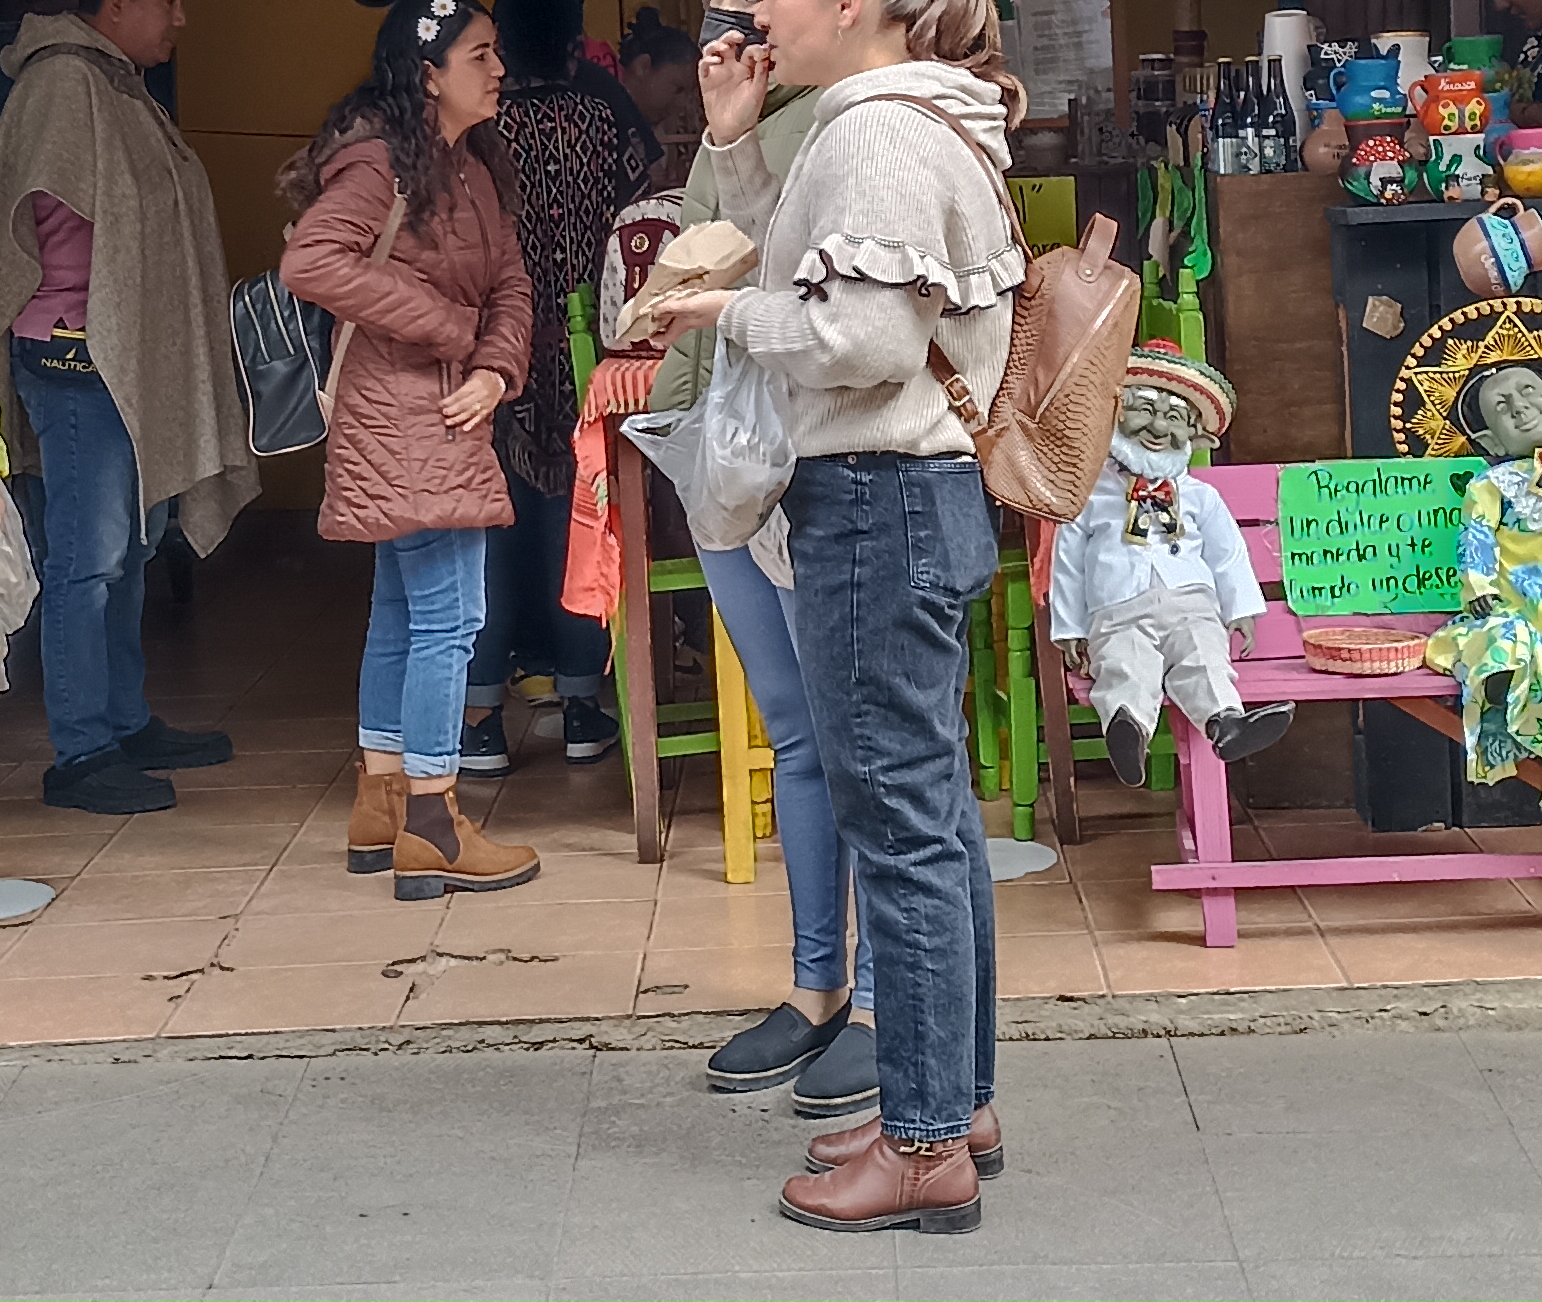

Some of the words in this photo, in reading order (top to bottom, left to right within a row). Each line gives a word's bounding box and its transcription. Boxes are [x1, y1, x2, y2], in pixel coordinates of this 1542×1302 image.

[1307, 466, 1435, 513] Regalame
[1417, 506, 1465, 530] una
[1290, 540, 1378, 566] moneda
[1388, 542, 1401, 569] y
[1406, 535, 1433, 557] te
[1402, 564, 1464, 595] dese
